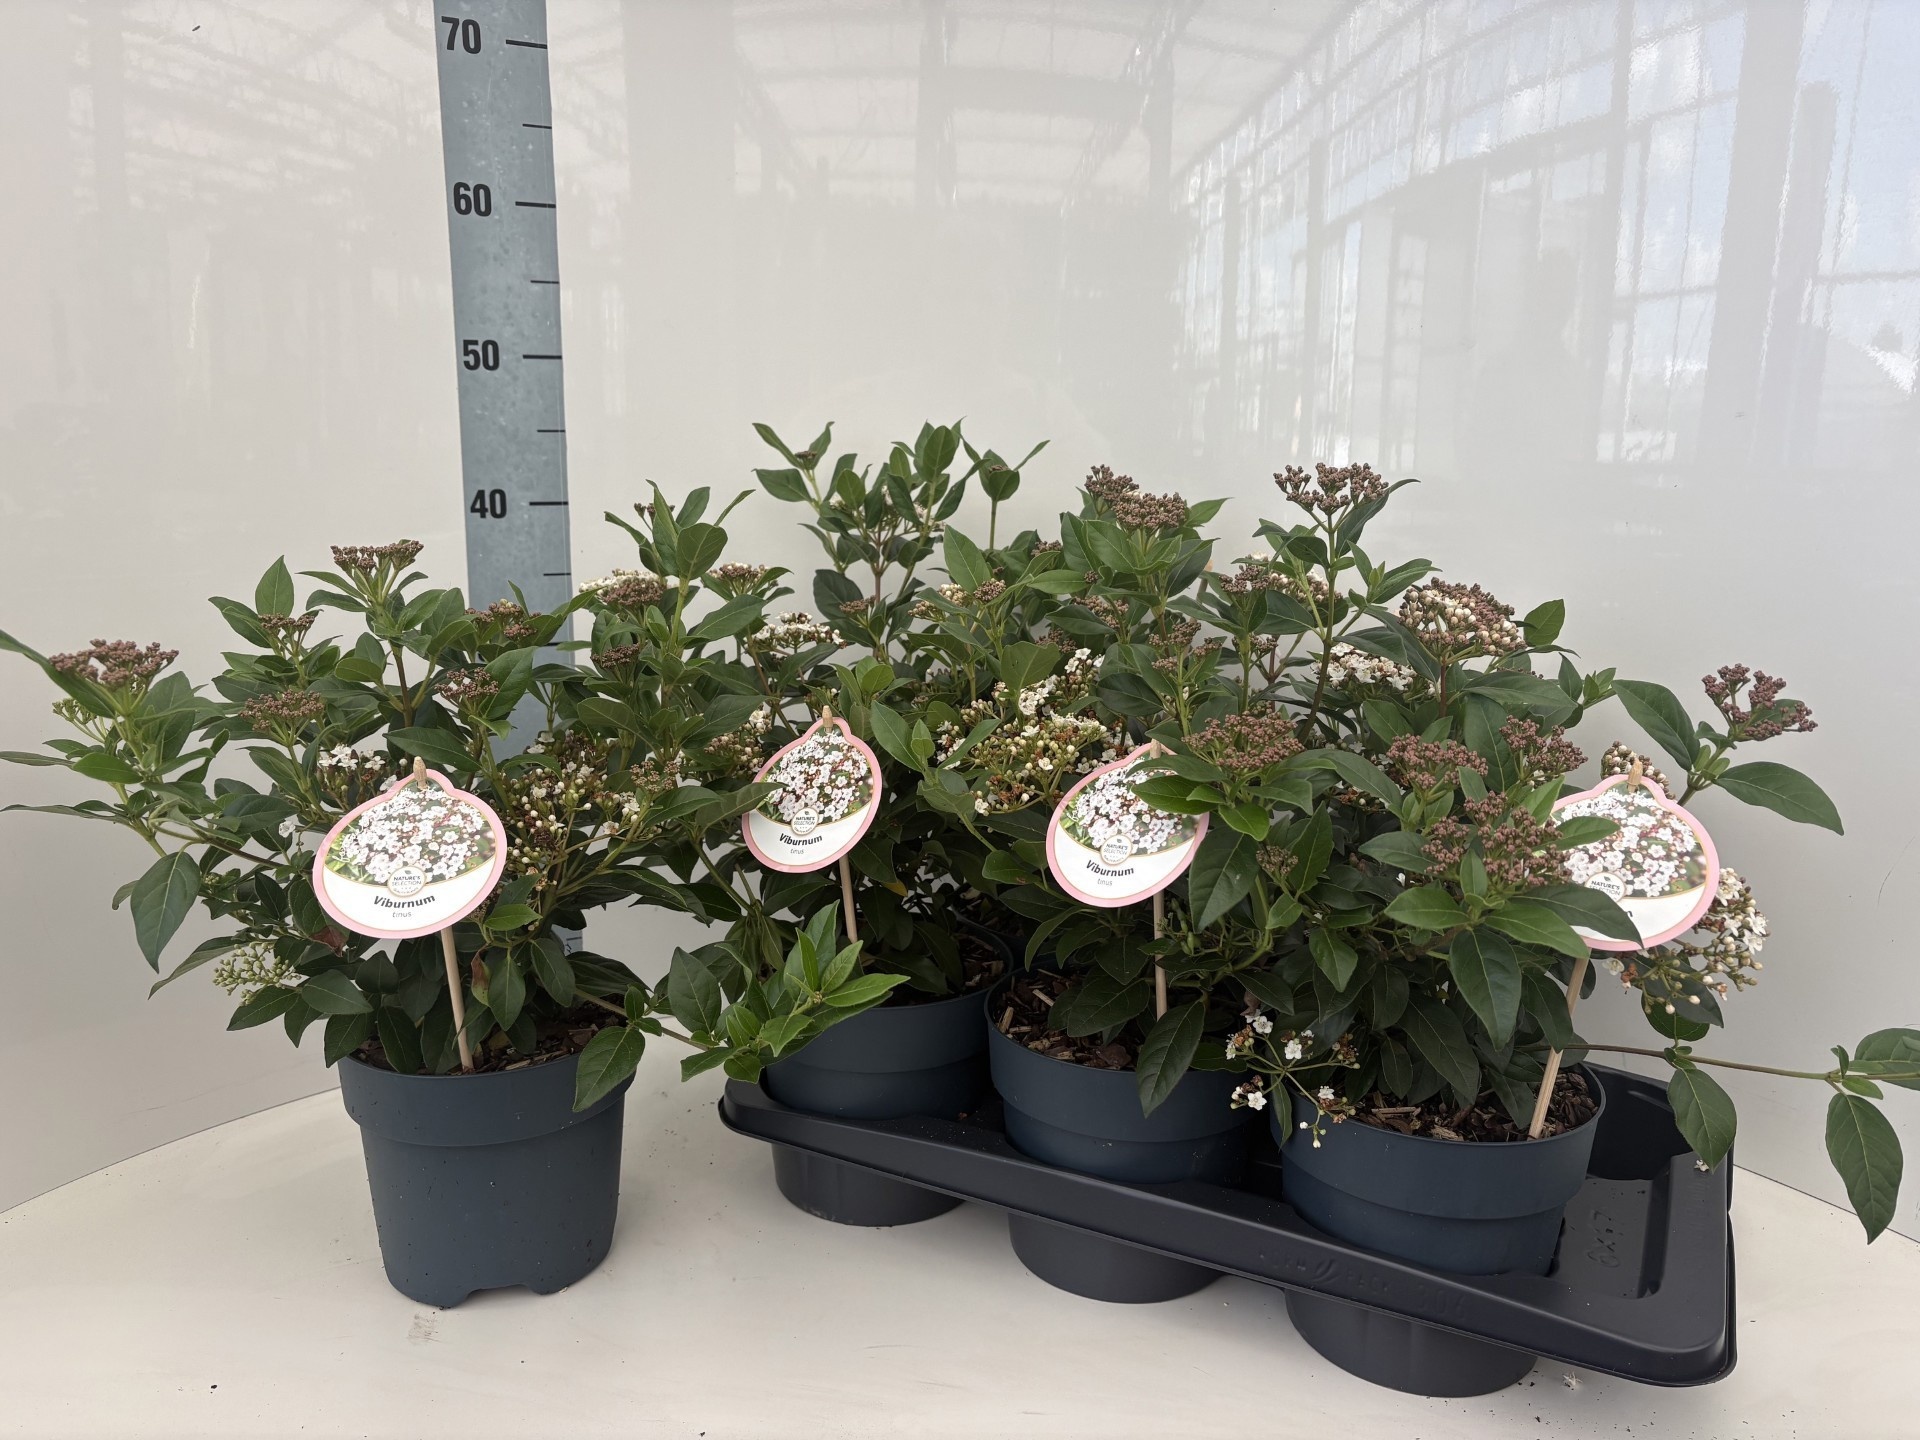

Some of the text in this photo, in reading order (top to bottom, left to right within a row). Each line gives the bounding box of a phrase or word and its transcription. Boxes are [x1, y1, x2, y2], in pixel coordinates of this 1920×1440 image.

[441, 15, 482, 54] 70
[453, 181, 492, 217] 60
[462, 339, 500, 371] 50
[470, 488, 507, 519] 40
[779, 832, 823, 846] Viburnum
[1086, 859, 1135, 877] Viburnum
[373, 894, 436, 909] Viburnum
[392, 910, 412, 918] tinus
